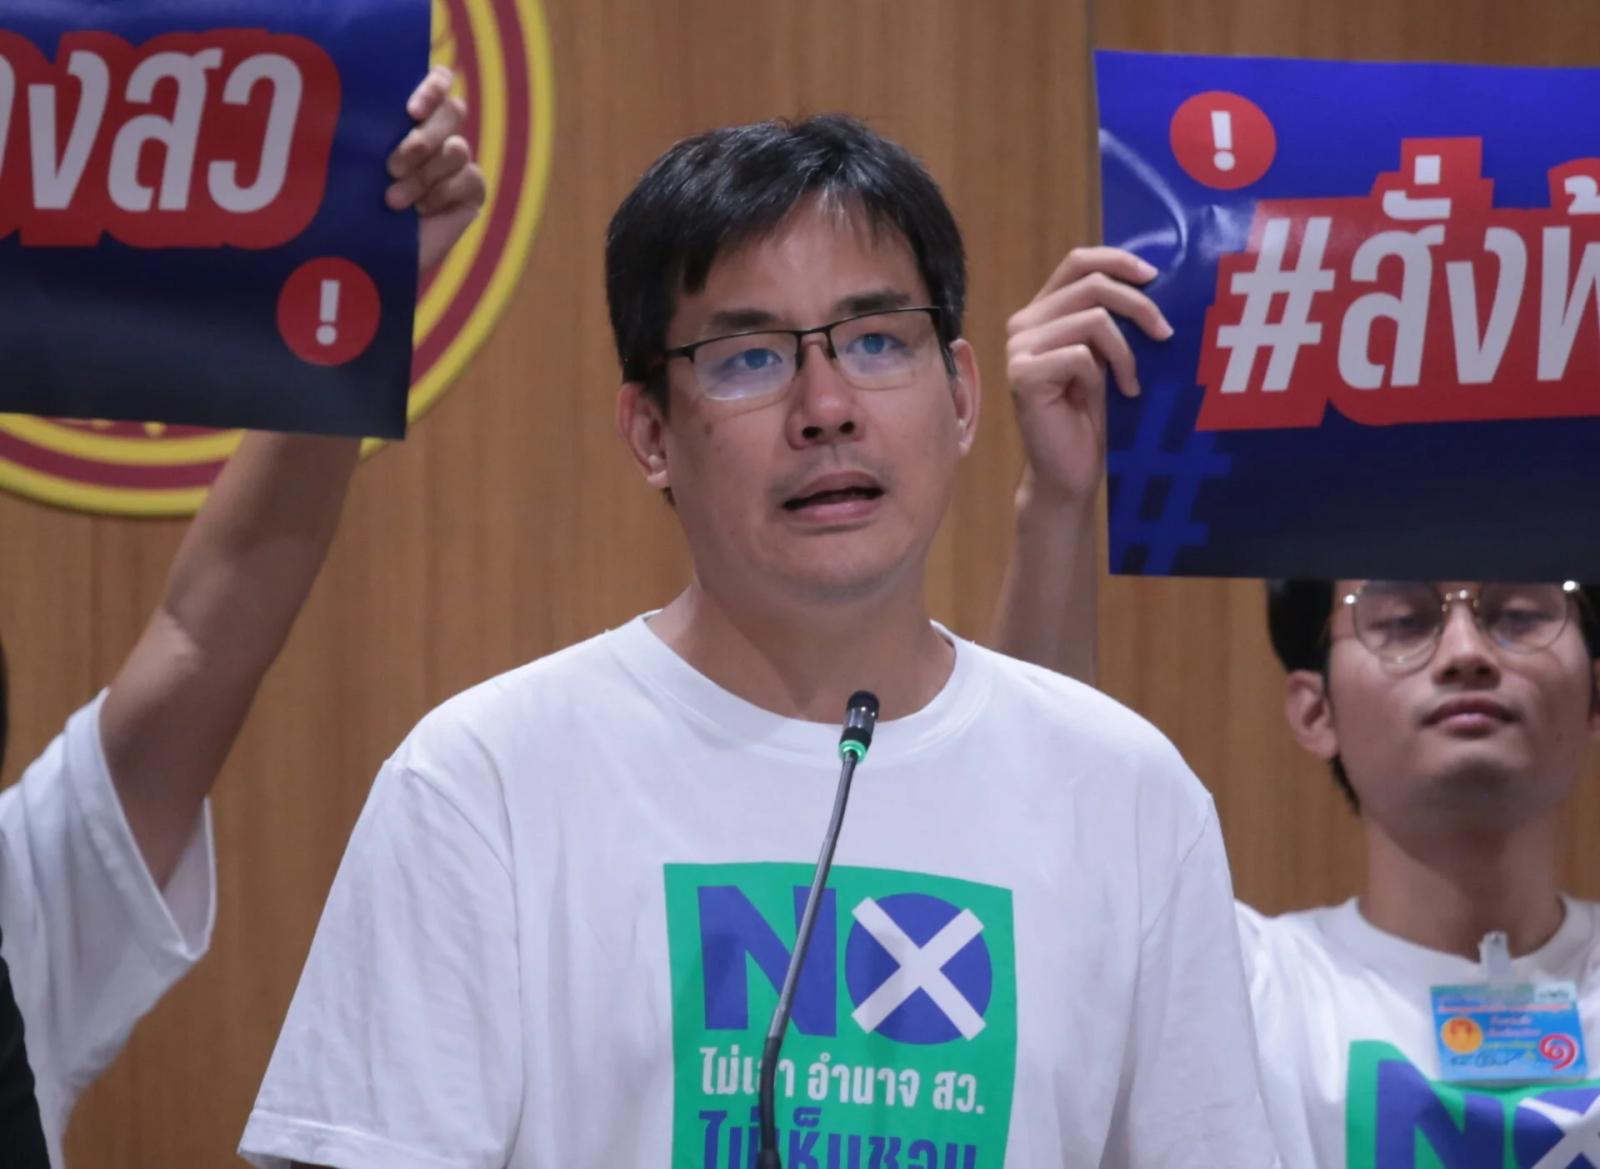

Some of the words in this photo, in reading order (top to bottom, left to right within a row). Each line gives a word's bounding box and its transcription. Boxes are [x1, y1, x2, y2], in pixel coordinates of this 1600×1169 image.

[0, 48, 303, 213] งสว
[699, 1044, 795, 1098] ไม่เา
[807, 1052, 920, 1107] อำนาจ
[932, 1070, 985, 1114] สว.
[698, 1106, 977, 1169] ไม่ห็นชอ
